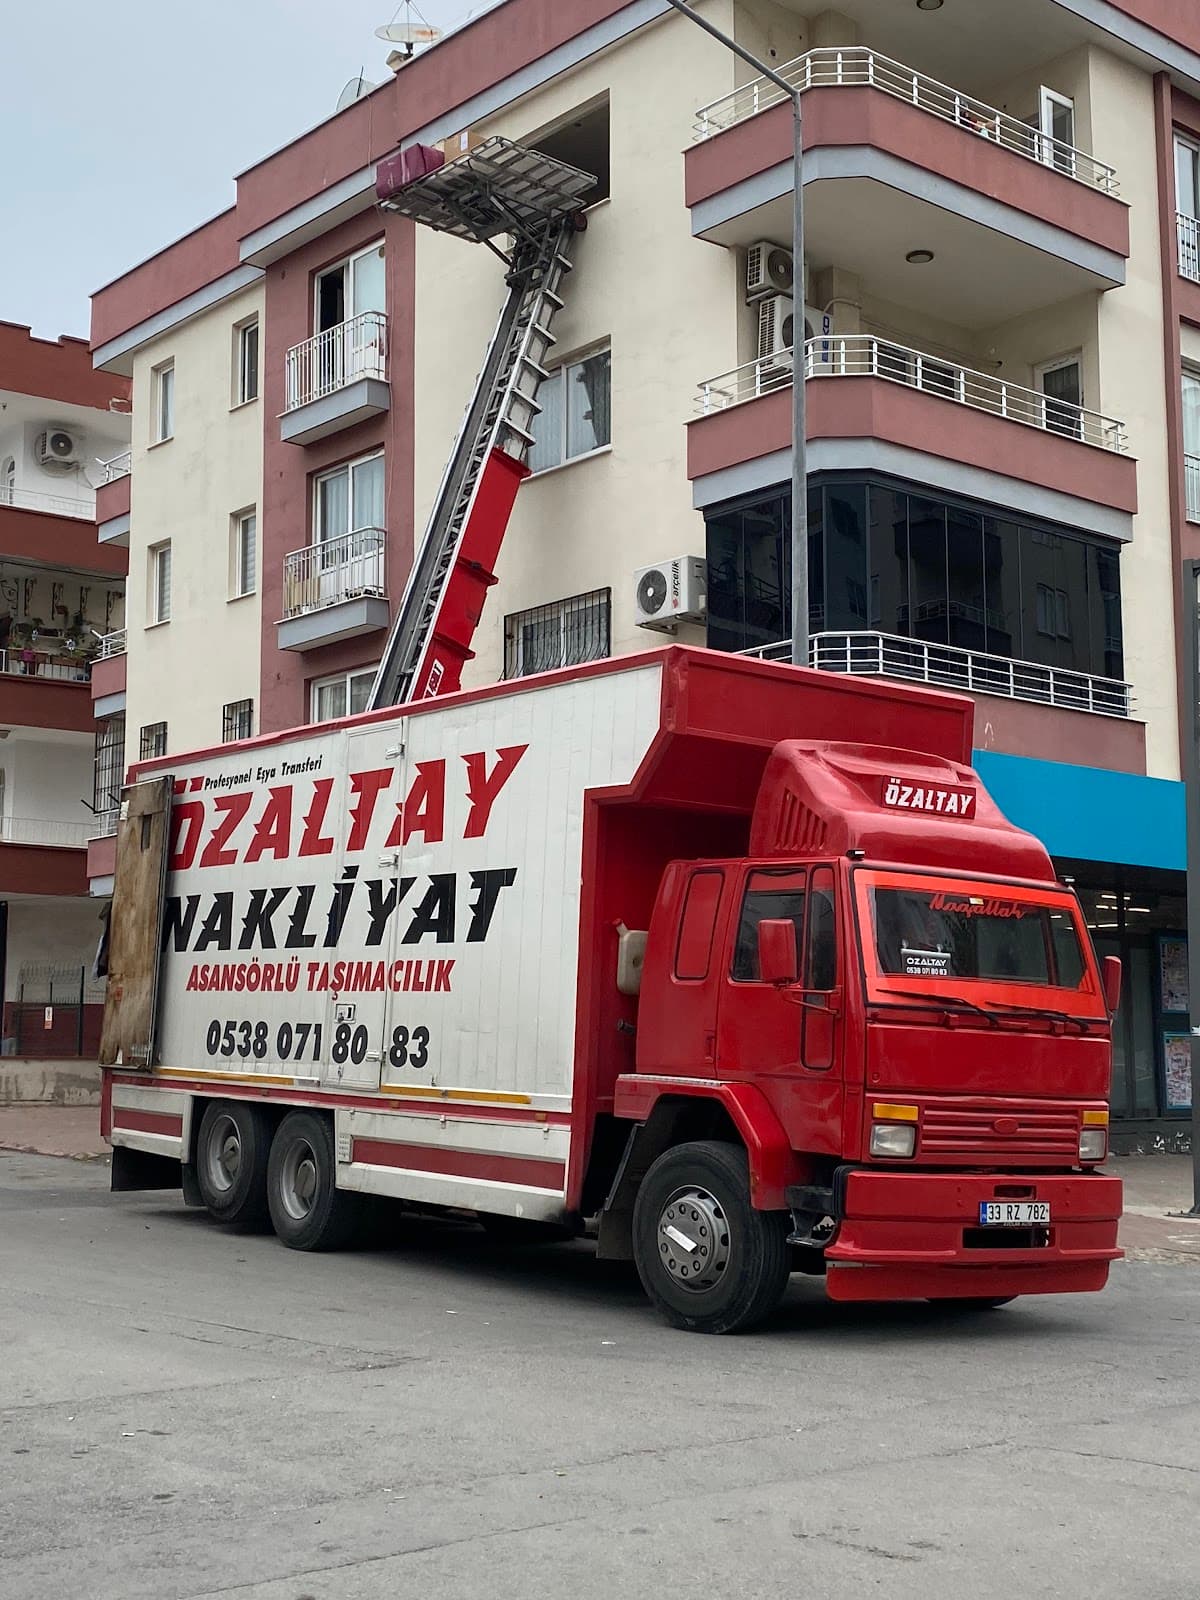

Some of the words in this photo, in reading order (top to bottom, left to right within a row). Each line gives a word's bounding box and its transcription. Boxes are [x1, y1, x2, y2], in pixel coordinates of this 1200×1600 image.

[671, 560, 681, 597] arçelik
[204, 768, 252, 791] Profesyonel
[256, 767, 277, 785] Eşya
[281, 754, 323, 777] Transferi
[168, 743, 530, 872] ÖZALTAY
[885, 777, 974, 816] ÖZALTAY
[161, 864, 518, 953] NAKLİYAT
[185, 956, 301, 992] ASANSÖRLÜ
[307, 959, 456, 1001] TAŞIMACILIK
[206, 1019, 268, 1059] 0538
[276, 1021, 323, 1061] 071
[332, 1022, 369, 1065] 80
[389, 1025, 430, 1069] 83
[988, 1204, 1001, 1220] 33
[1007, 1204, 1020, 1220] RZ
[1027, 1204, 1046, 1220] 782
